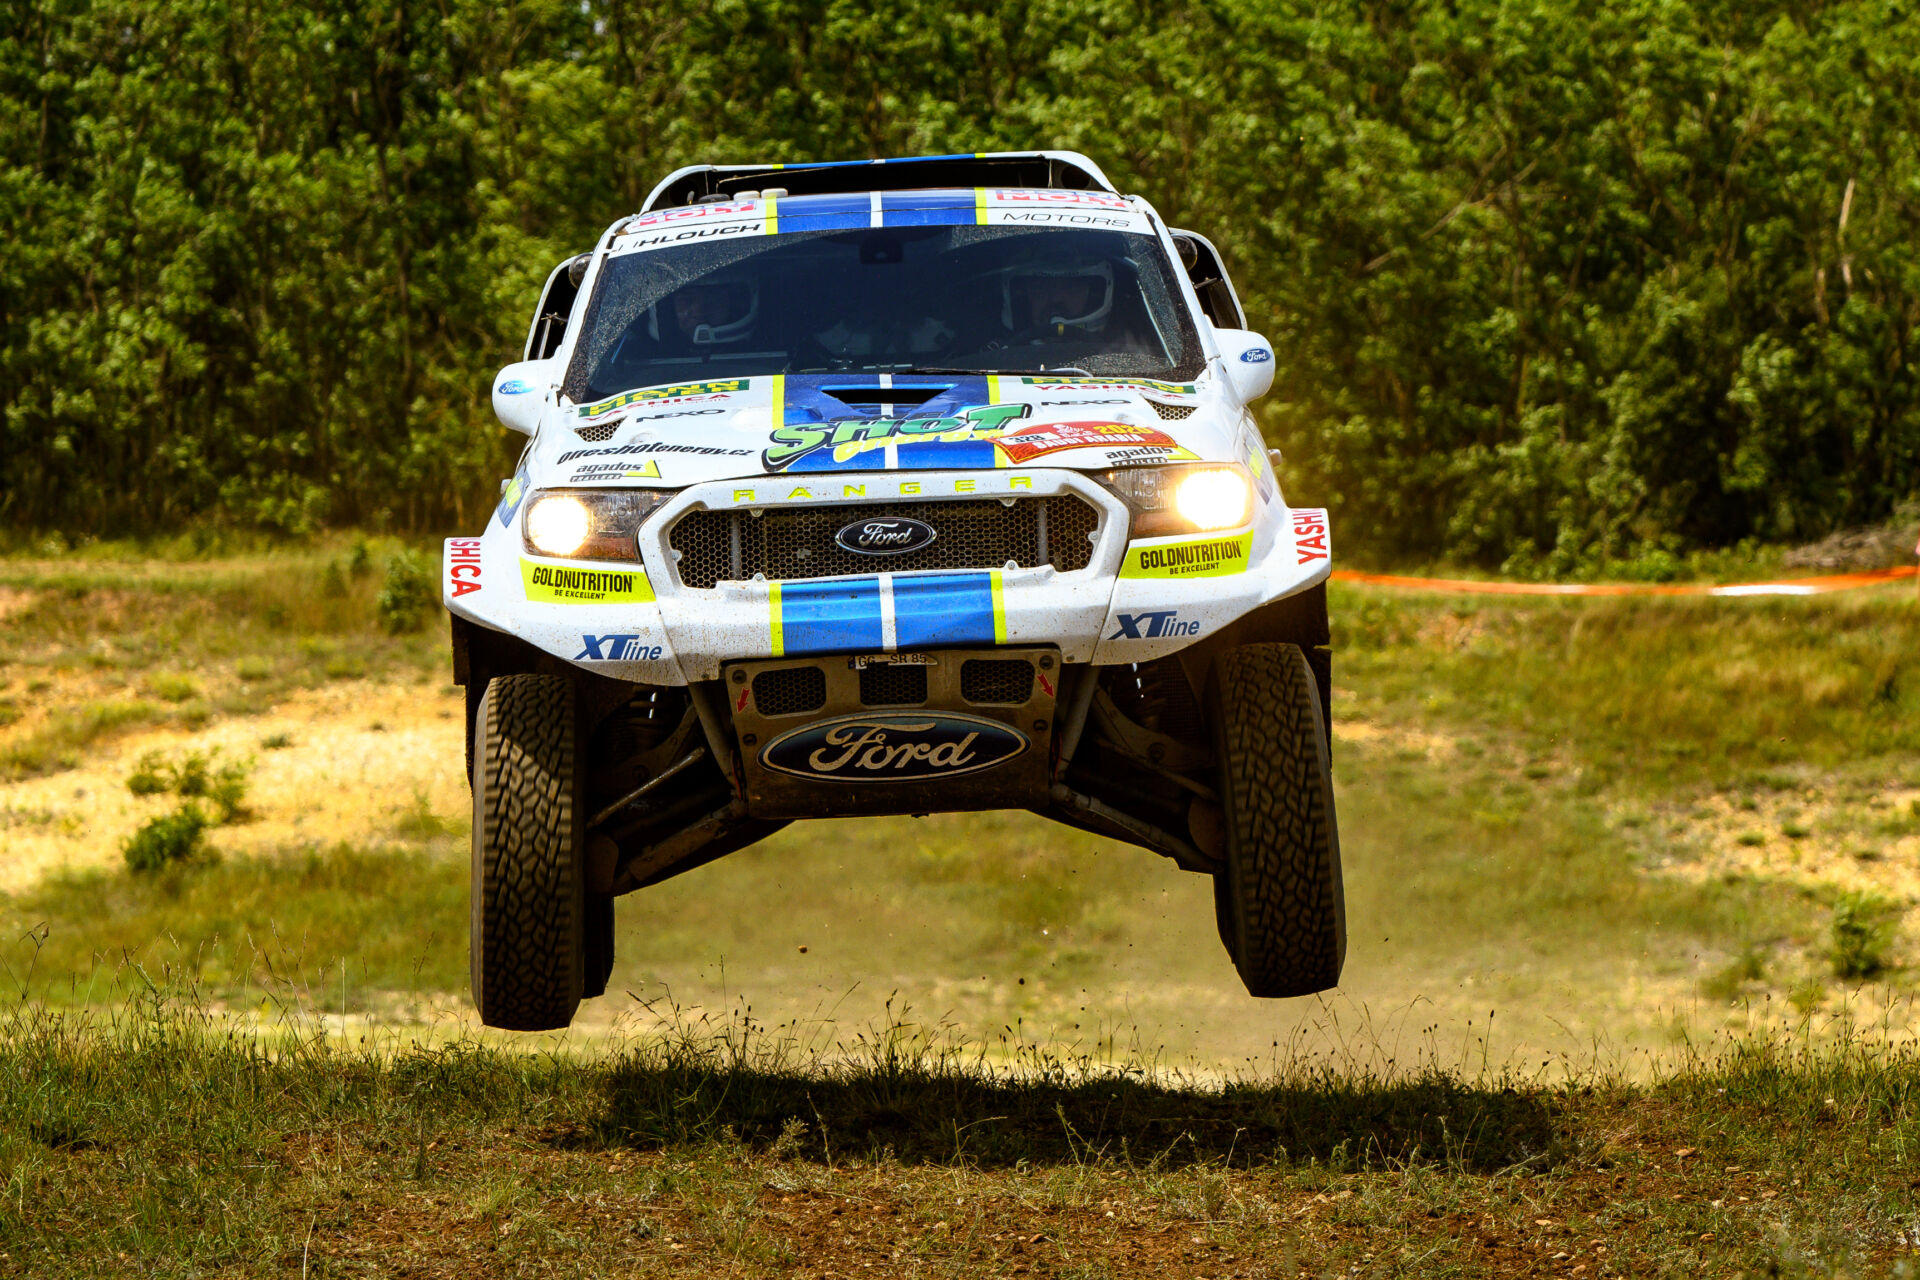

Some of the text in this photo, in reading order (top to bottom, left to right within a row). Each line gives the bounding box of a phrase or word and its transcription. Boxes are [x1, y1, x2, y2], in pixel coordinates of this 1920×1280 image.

[1003, 212, 1131, 228] MOTORS
[1246, 349, 1267, 362] Ford
[636, 409, 727, 423] NEXO
[762, 403, 1032, 472] SHOT
[1031, 437, 1085, 450] SAUDI
[1084, 432, 1147, 444] ARABIA
[1093, 424, 1155, 436] 2020
[556, 442, 755, 465] oneshotenergy.cz
[1105, 446, 1174, 460] agados
[576, 461, 644, 475] agados
[733, 476, 1033, 502] RANGER
[858, 522, 913, 546] Ford
[1140, 540, 1243, 570] GOLDNUTRITION
[450, 537, 482, 599] SHICA
[532, 566, 633, 593] GOLDNUTRITION
[1169, 562, 1220, 575] BE EXCELLENT
[554, 589, 606, 600] BE EXCELLENT
[1106, 610, 1200, 641] XTline
[573, 634, 663, 661] XTline
[808, 721, 979, 772] Ford
